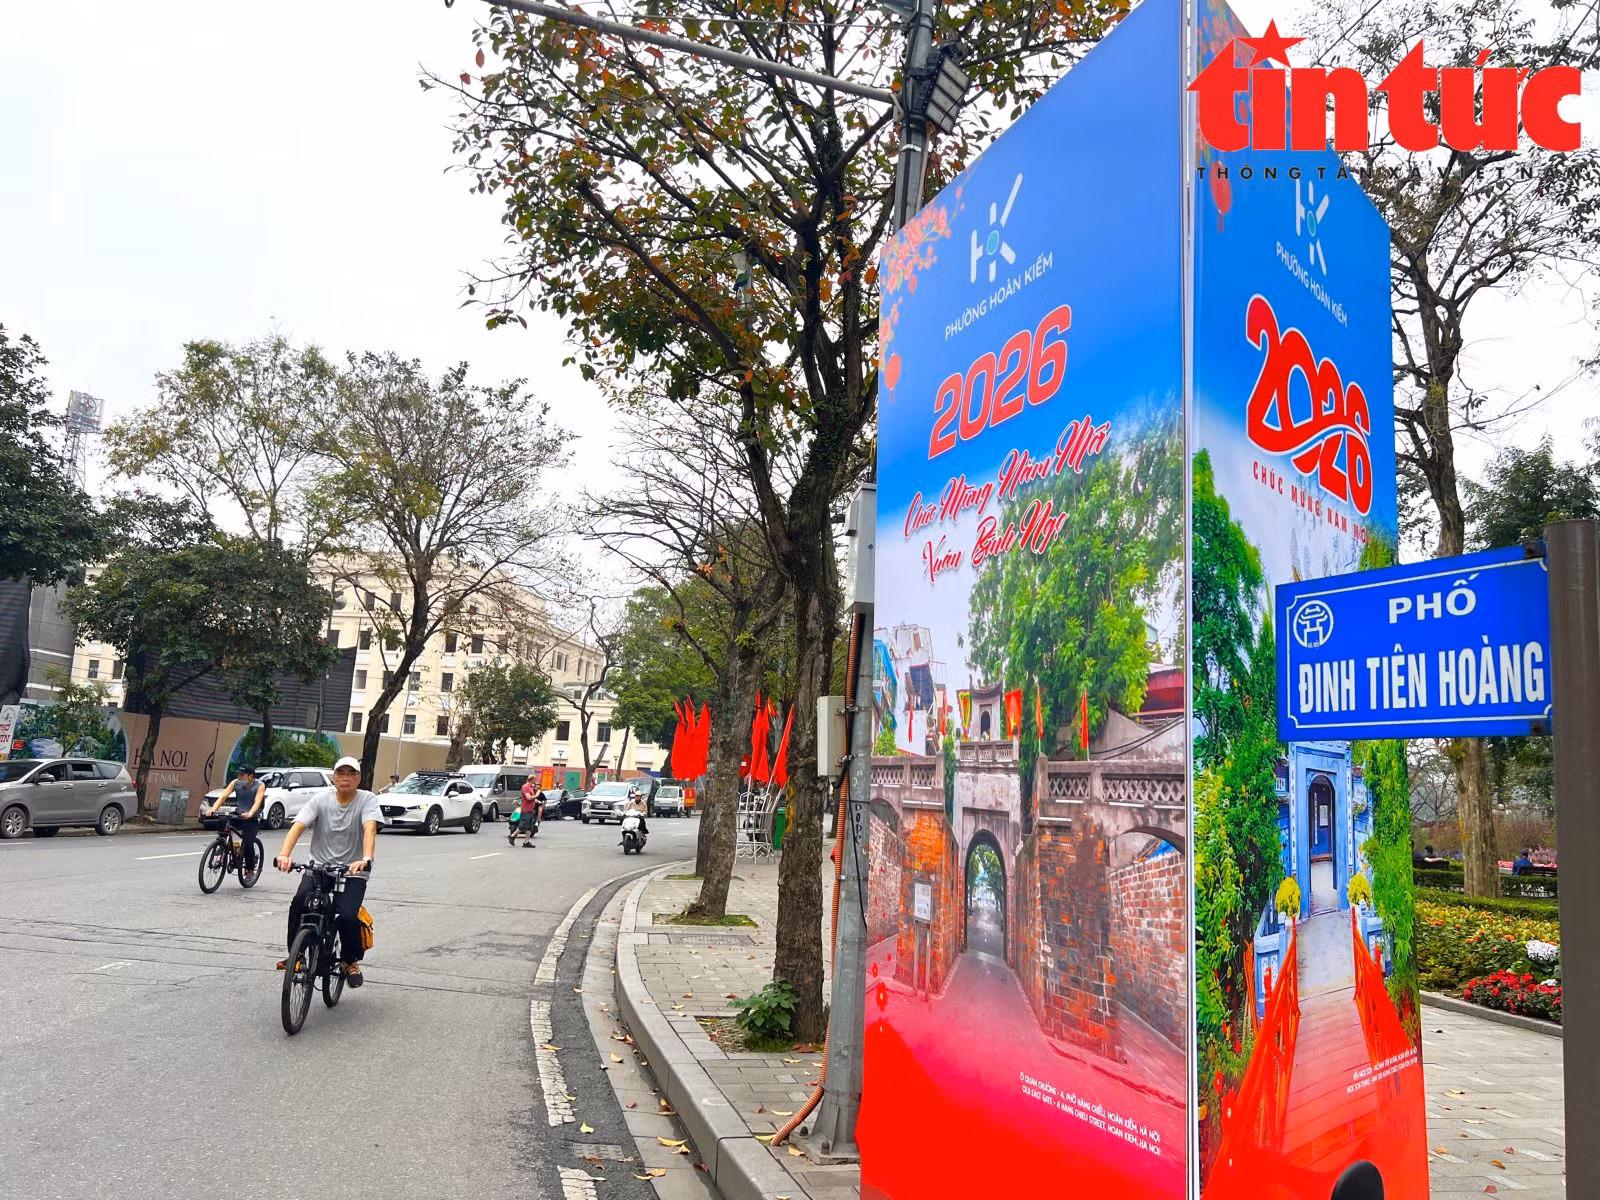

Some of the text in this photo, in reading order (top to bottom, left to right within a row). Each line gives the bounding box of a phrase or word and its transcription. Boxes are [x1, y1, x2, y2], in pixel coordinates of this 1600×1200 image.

[944, 250, 1053, 341] PHƯỜNG HOÀN KIẾM
[1276, 240, 1309, 289] PHƯỜNG
[1310, 277, 1331, 311] HOÀN
[928, 303, 1073, 461] 2026
[904, 491, 938, 540] Chúc
[998, 448, 1052, 501] Năm
[1253, 460, 1284, 495] CHÚC
[1388, 572, 1480, 624] PHỐ
[1298, 634, 1545, 714] ĐINH TIÊN HOÀNG
